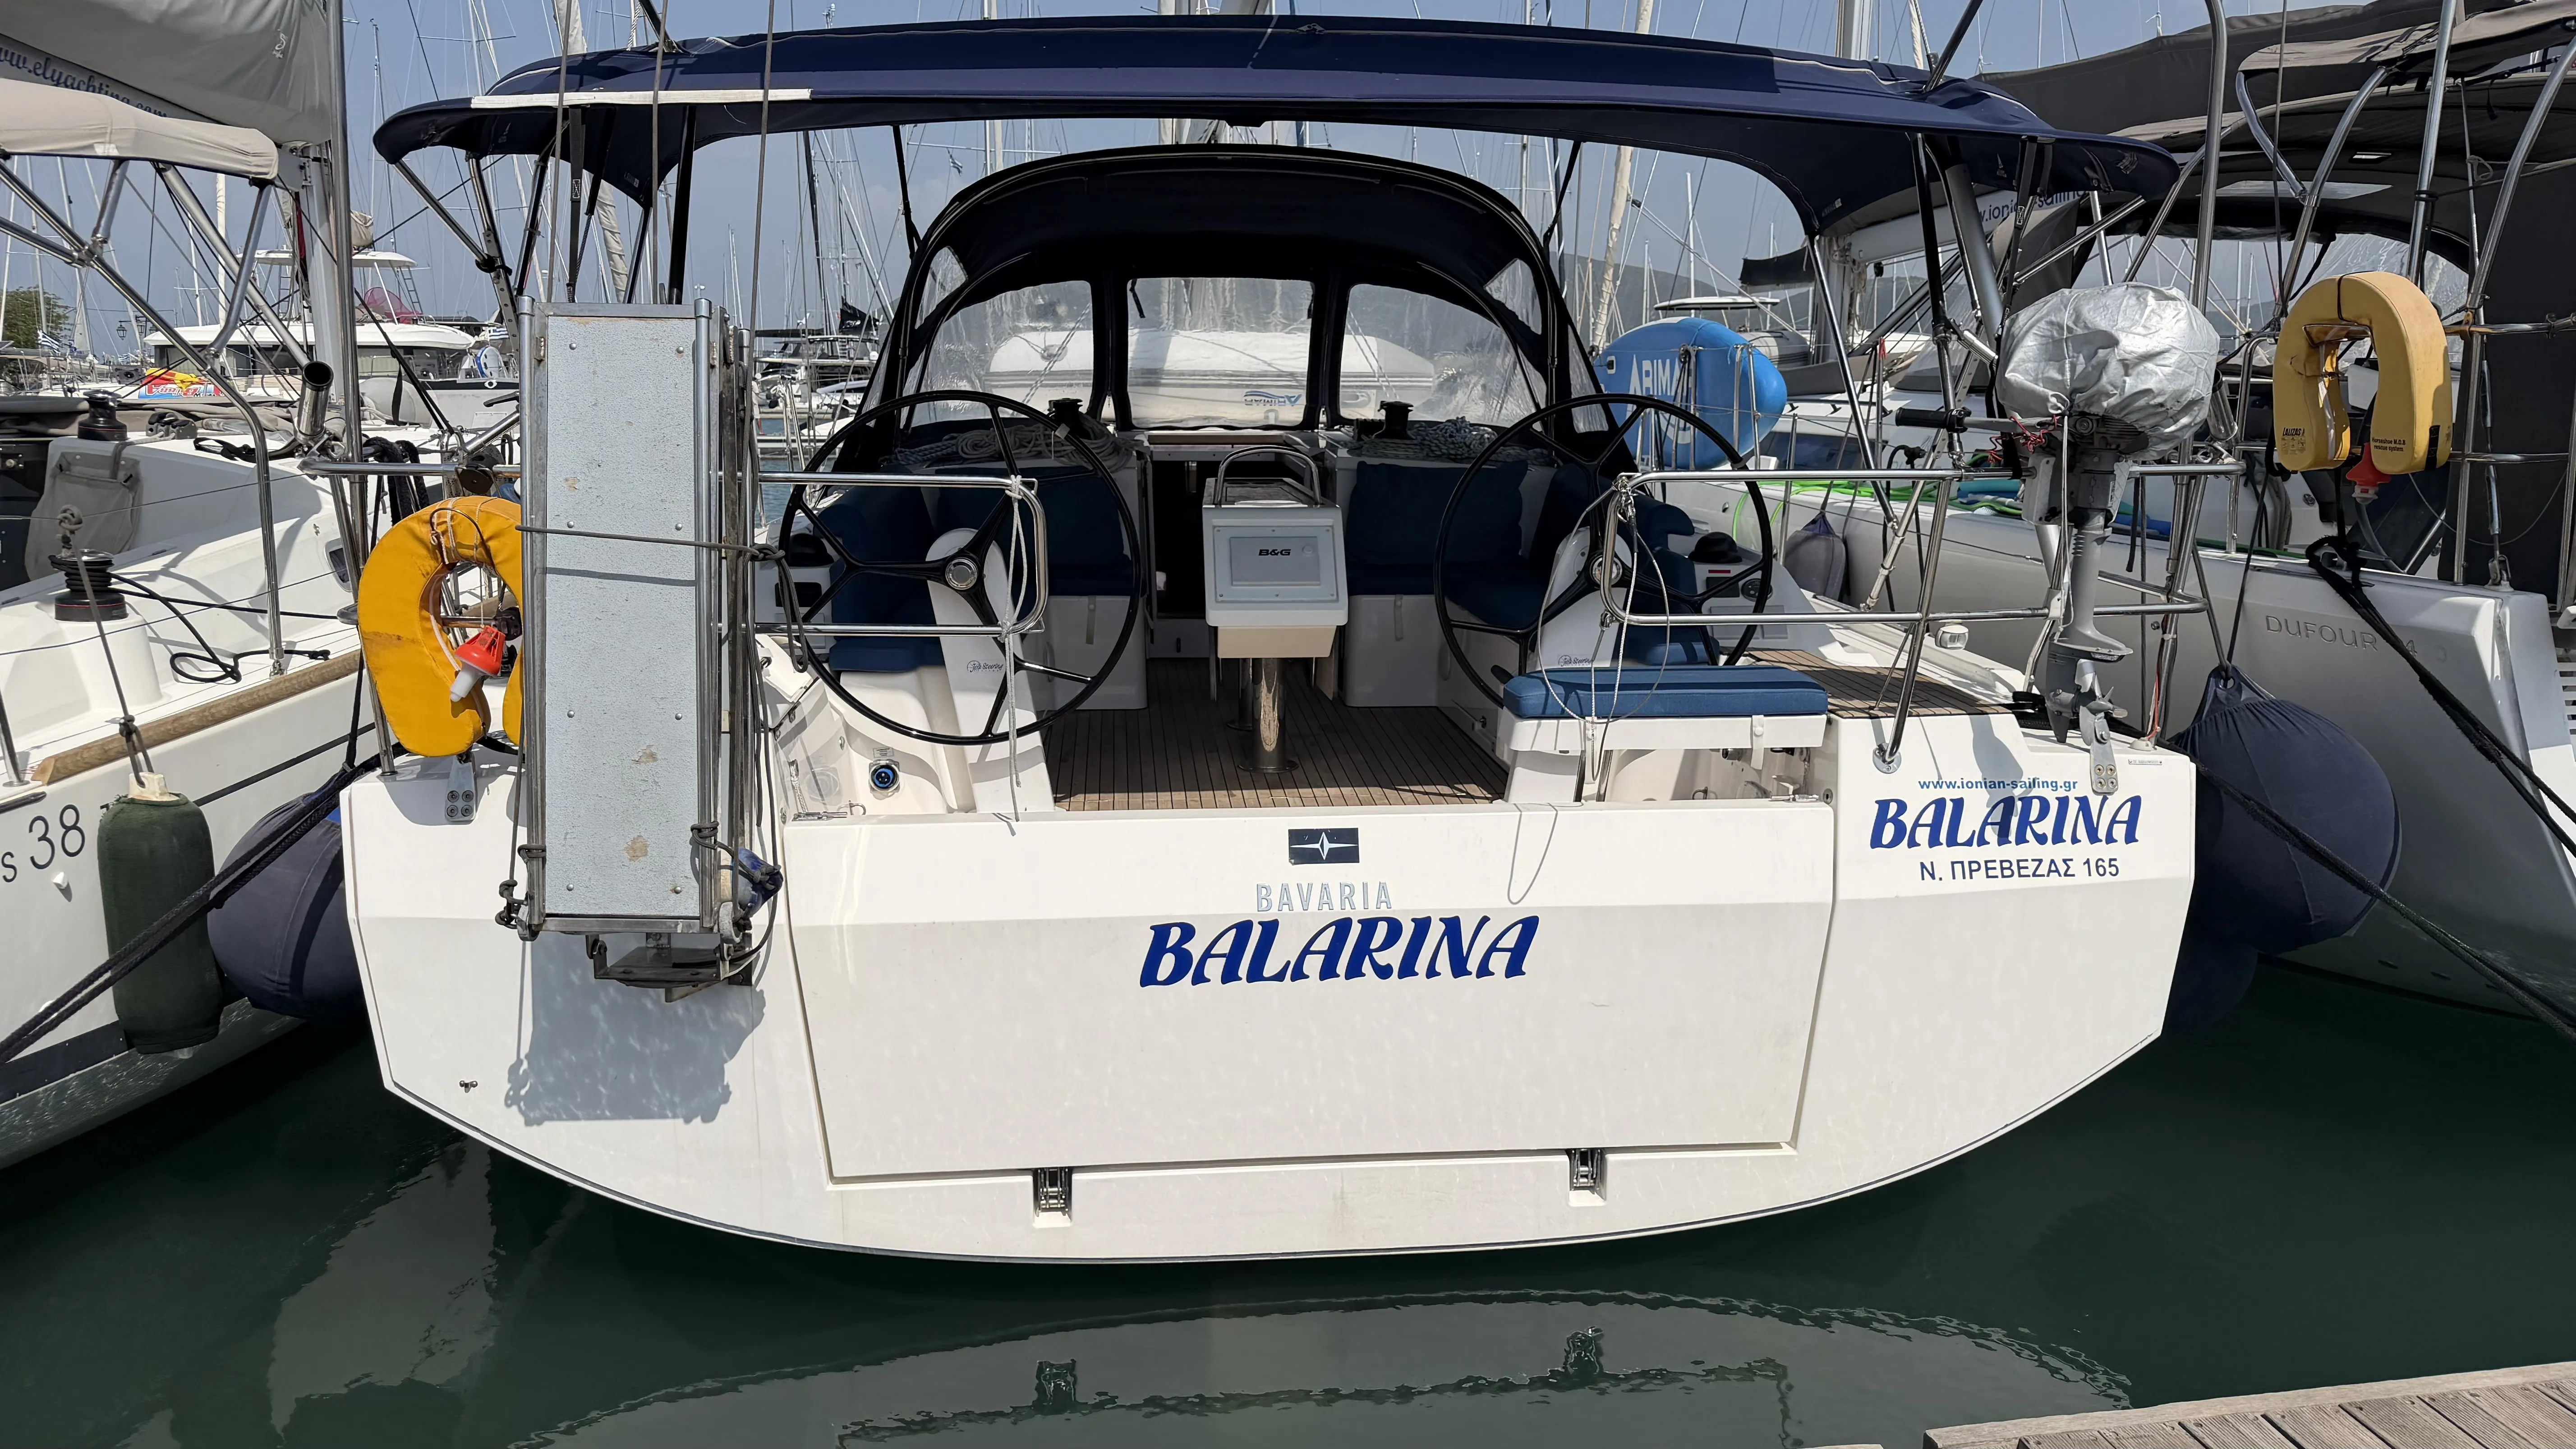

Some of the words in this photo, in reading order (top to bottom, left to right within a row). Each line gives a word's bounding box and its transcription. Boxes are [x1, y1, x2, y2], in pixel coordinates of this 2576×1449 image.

[2265, 615, 2378, 652] DUFOUR
[1918, 777, 2078, 792] www.ionian-sailing.gr
[29, 804, 85, 869] 38
[1870, 795, 2142, 849] BALARINA
[1950, 858, 2074, 879] ΠΡΕΒΕΖΑΣ
[2083, 858, 2120, 877] 165
[1256, 881, 1392, 912] BAVARIA
[1140, 915, 1539, 988] BALARINA
